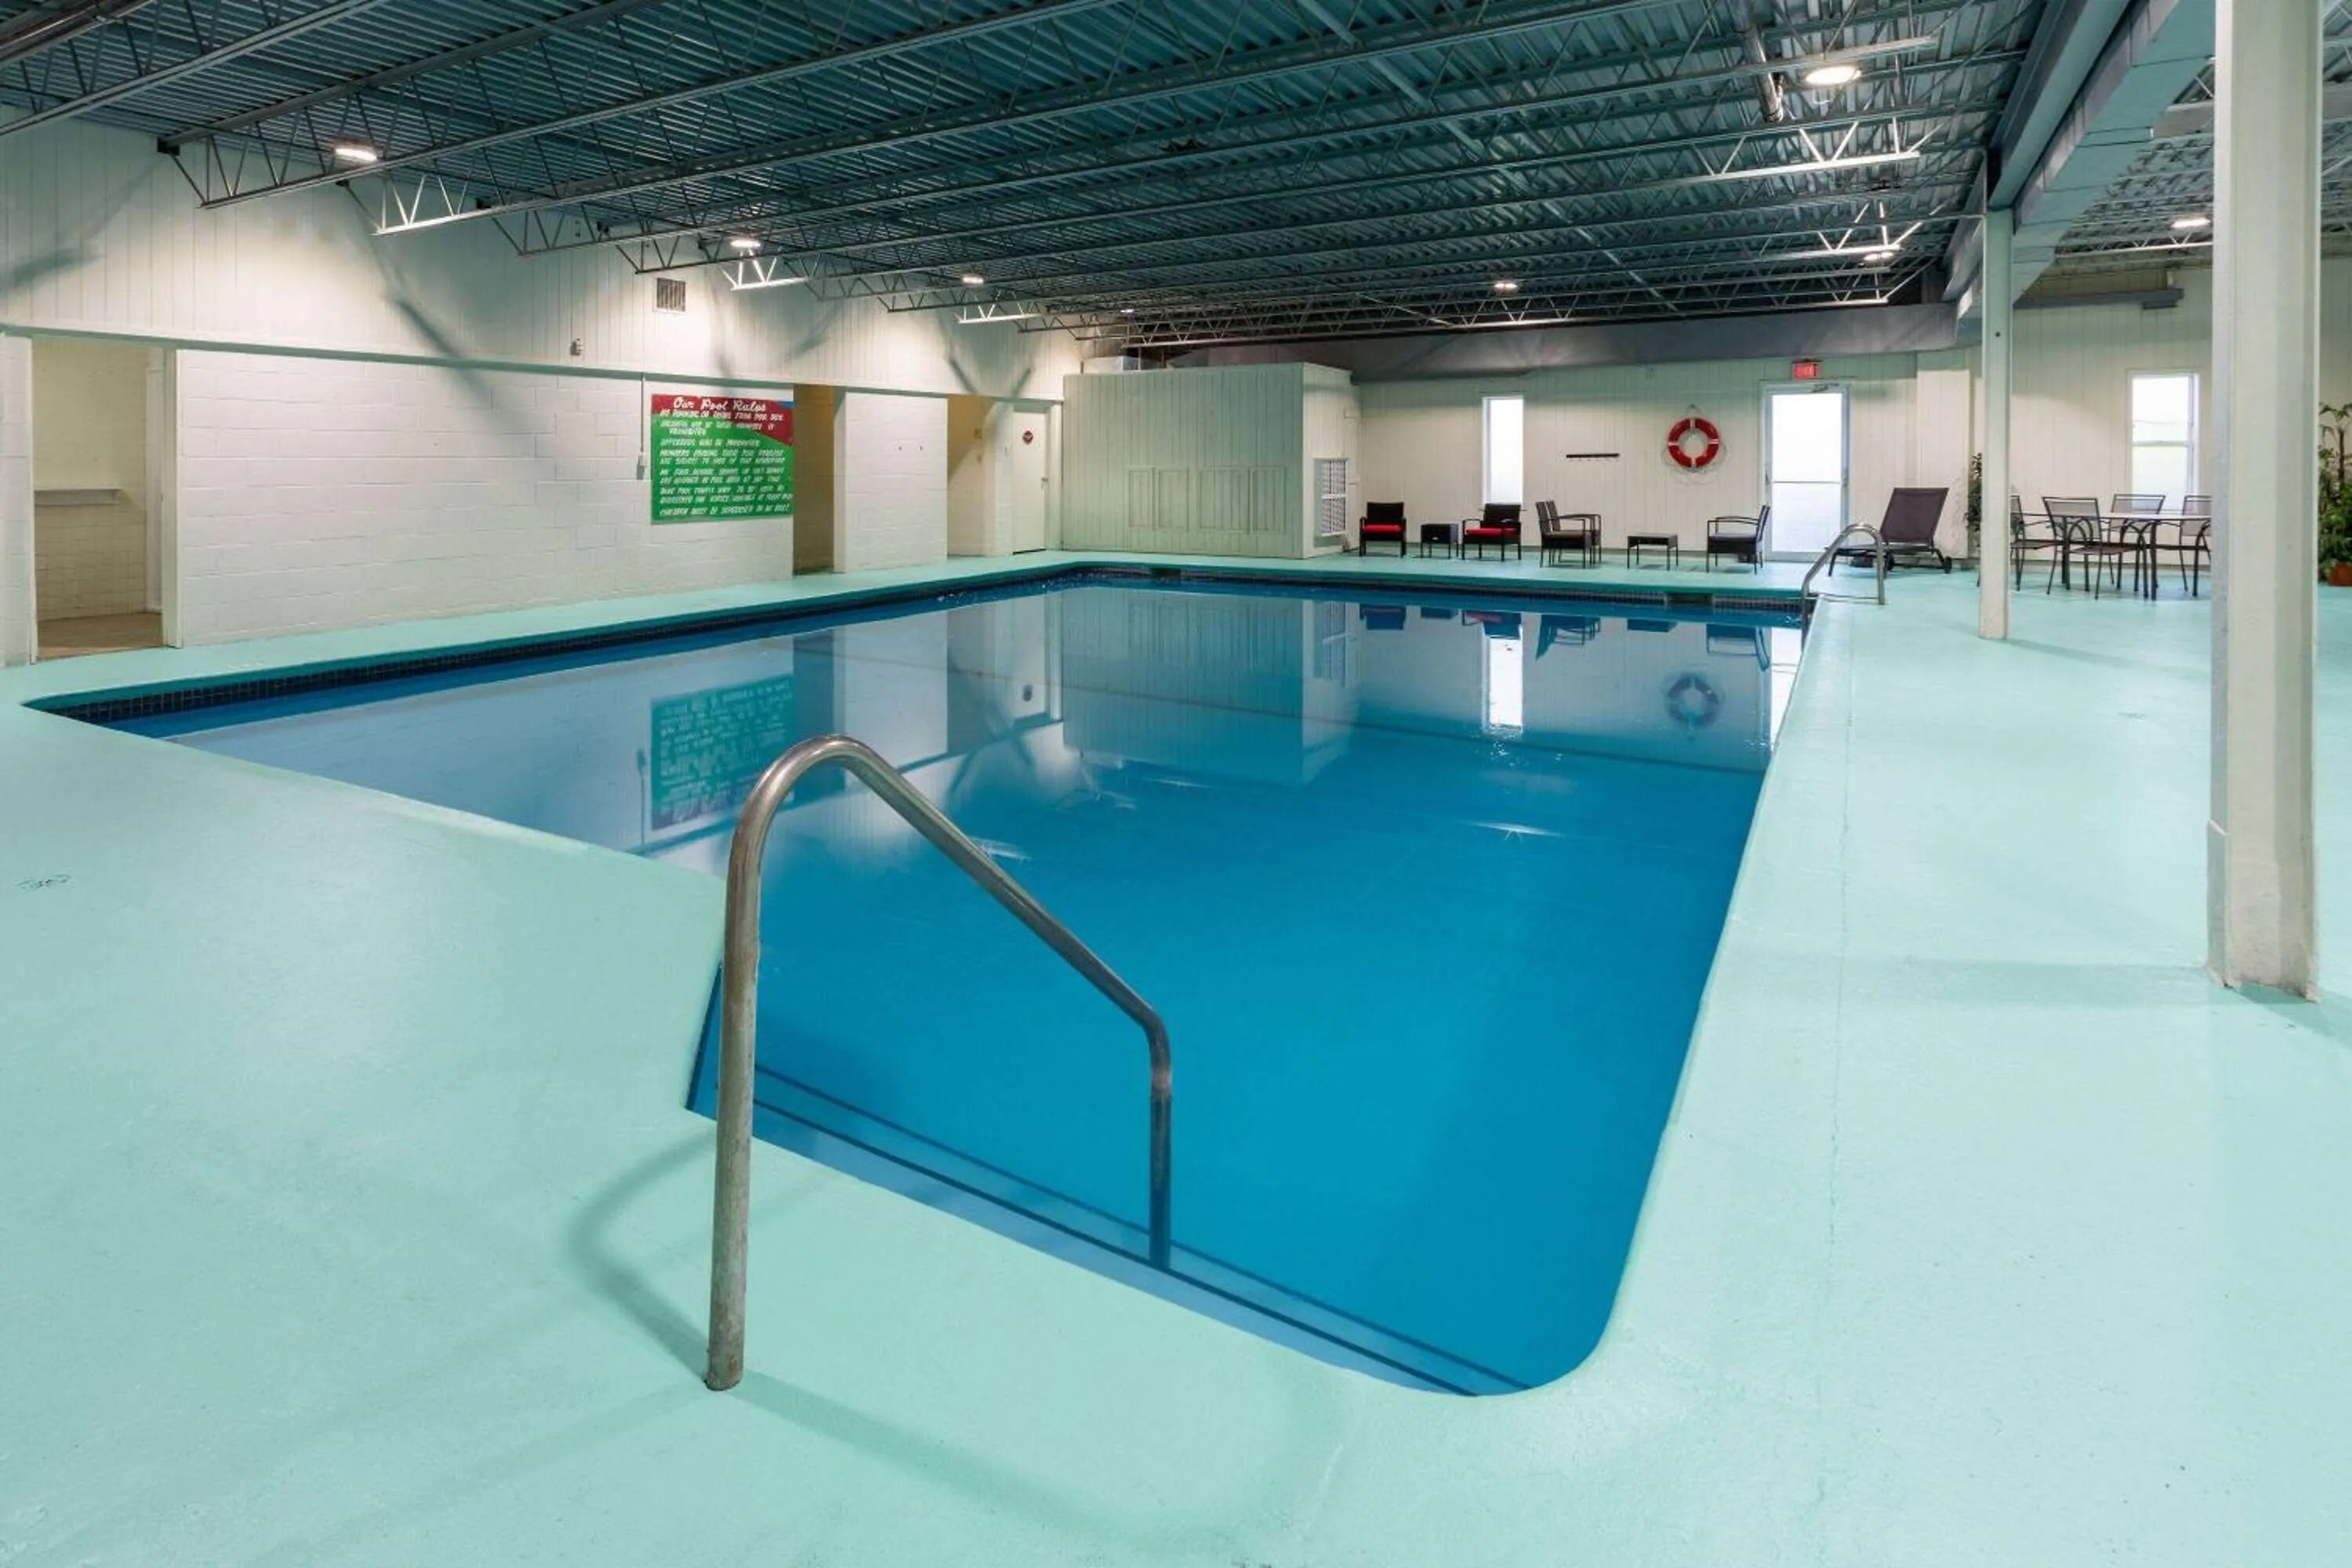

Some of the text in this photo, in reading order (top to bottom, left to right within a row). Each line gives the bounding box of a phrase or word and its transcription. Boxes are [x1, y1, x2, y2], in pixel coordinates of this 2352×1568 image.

[673, 397, 766, 412] Our Pool Rules
